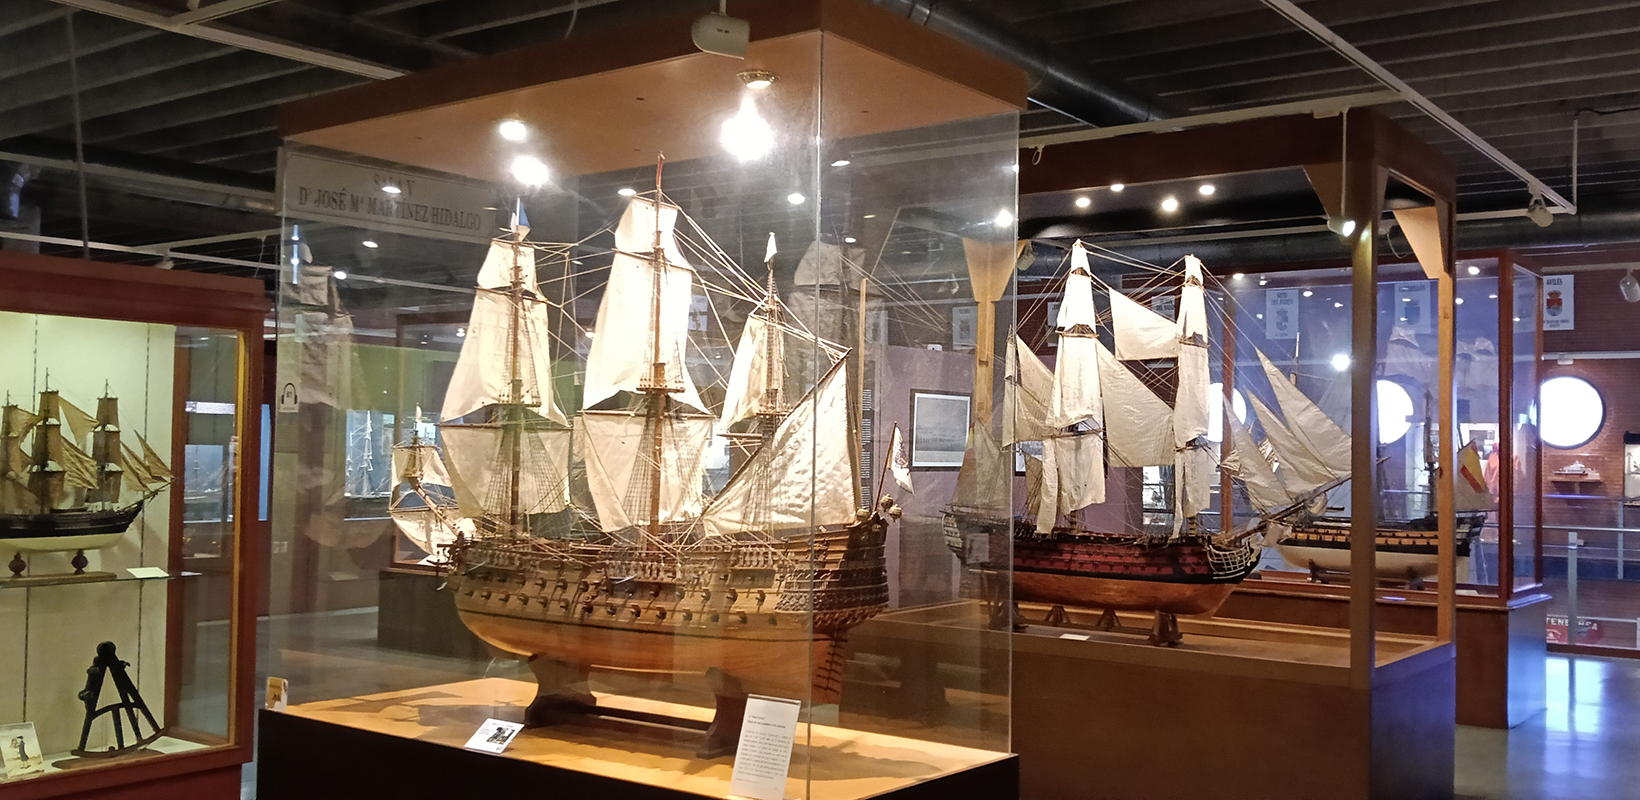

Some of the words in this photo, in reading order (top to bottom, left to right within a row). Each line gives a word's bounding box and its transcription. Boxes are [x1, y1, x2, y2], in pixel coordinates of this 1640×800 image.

[313, 187, 346, 211] JOSÉ
[367, 197, 428, 223] MARTÍNEZ
[431, 206, 482, 231] HIDALGO
